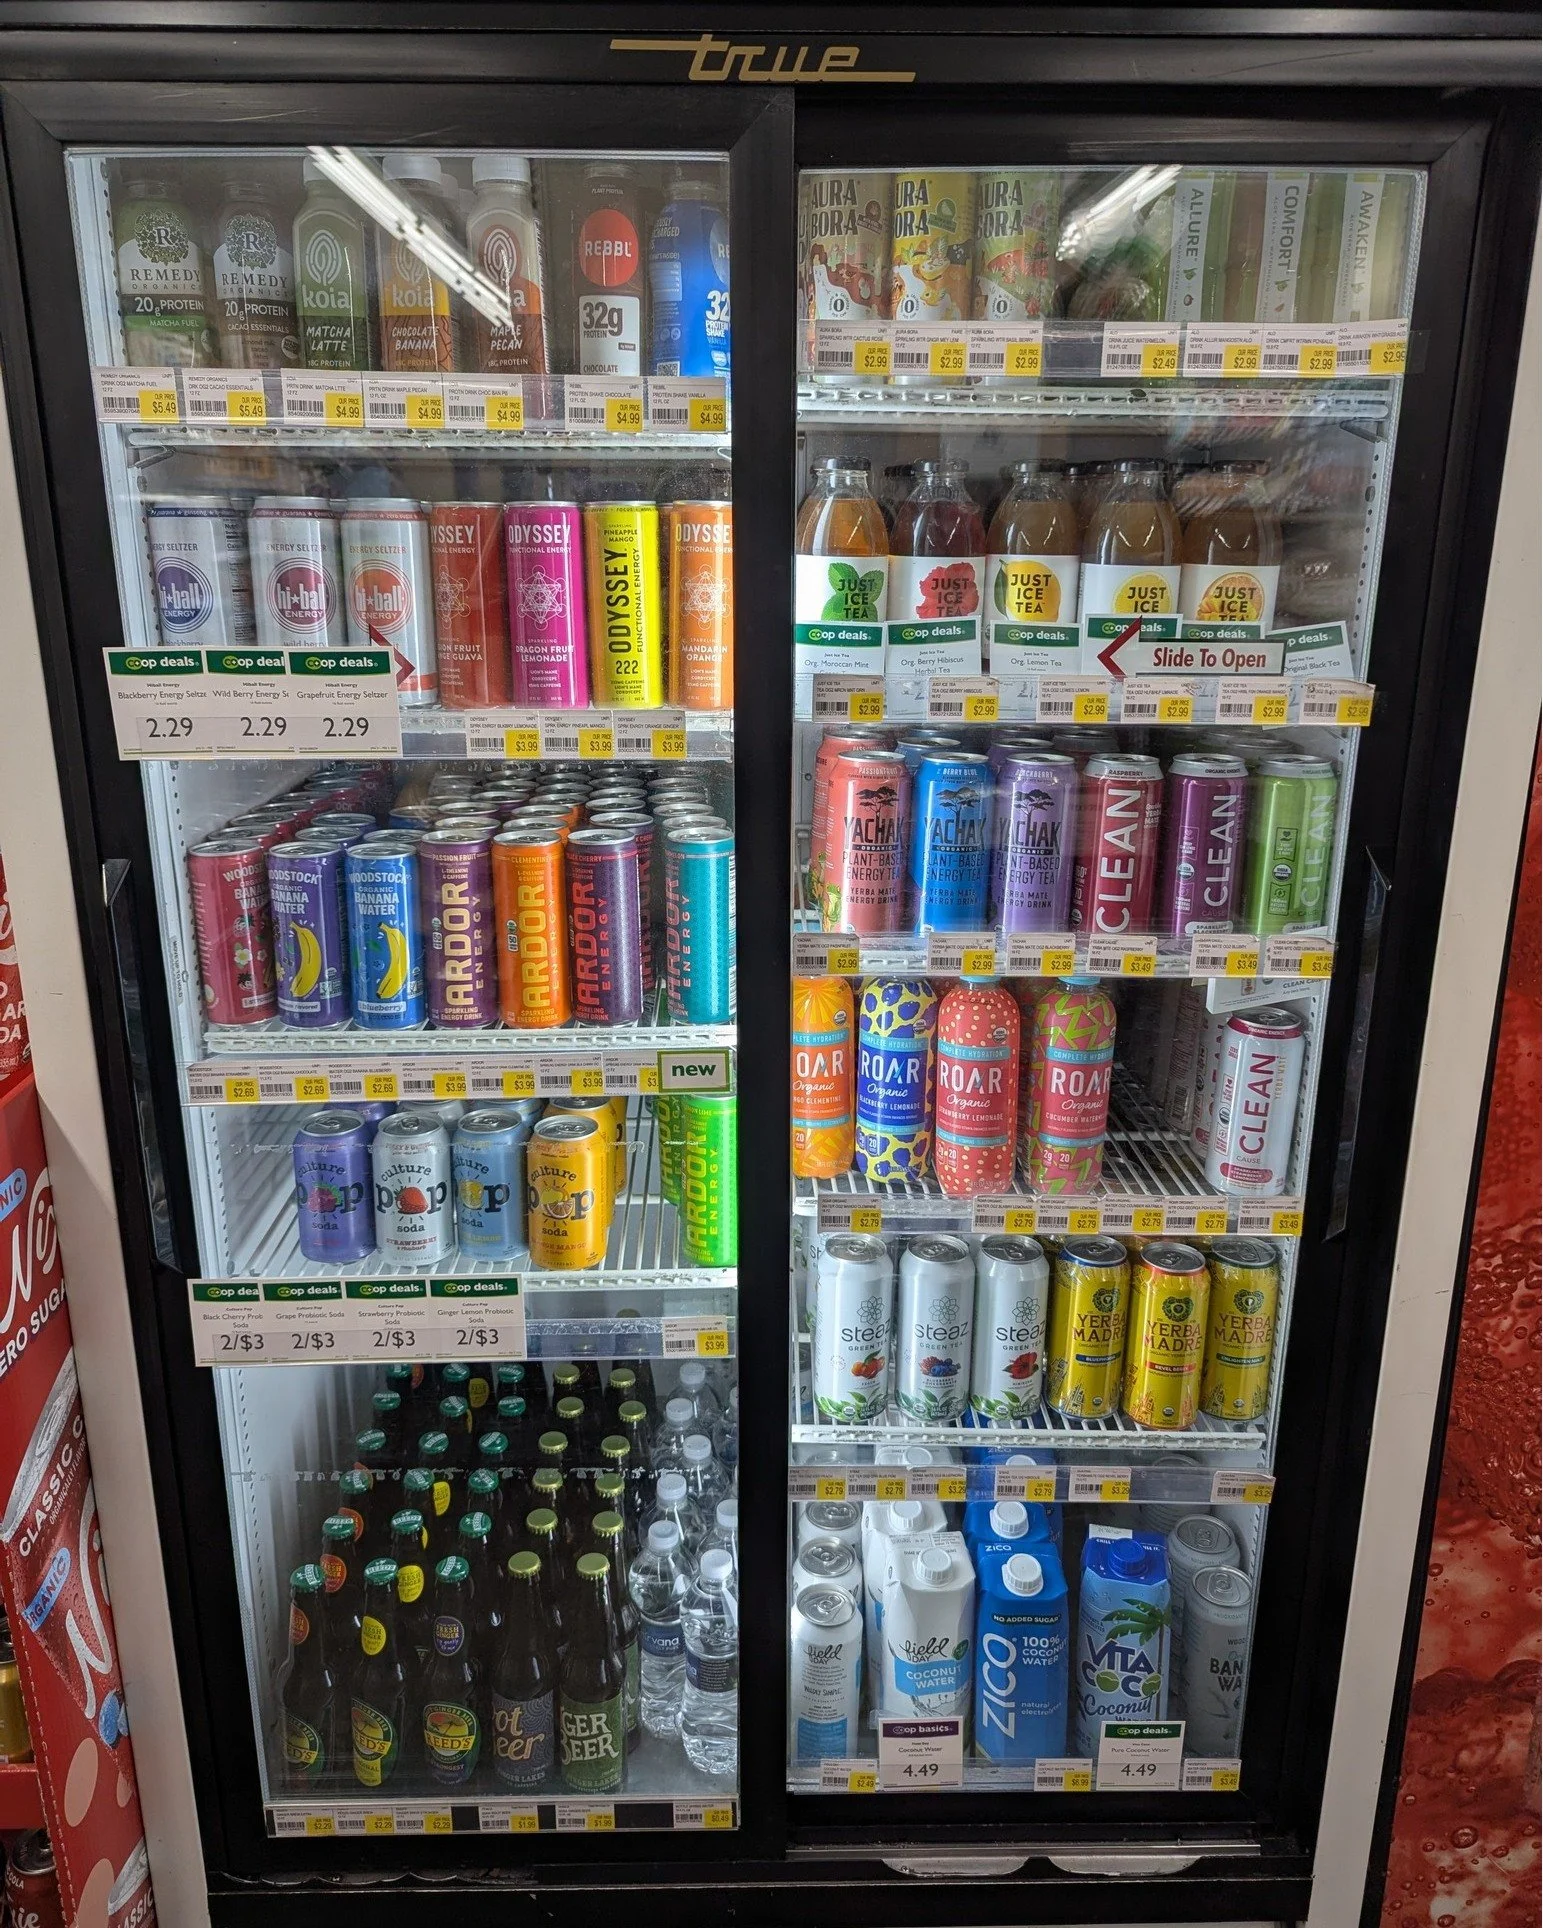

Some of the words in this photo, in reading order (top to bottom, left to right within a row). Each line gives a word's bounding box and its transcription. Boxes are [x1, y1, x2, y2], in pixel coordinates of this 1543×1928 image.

[611, 34, 915, 81] true
[811, 179, 858, 209] AURA
[811, 209, 860, 239] BORA
[1184, 187, 1205, 257] ALLURE
[1281, 185, 1300, 271] COMFORT
[1352, 189, 1375, 272] AWAKEN
[585, 240, 632, 258] REBBL
[130, 268, 201, 281] REMEDY
[221, 273, 288, 288] REMEDY
[302, 285, 351, 309] koia
[392, 286, 435, 308] koia
[161, 300, 204, 311] PROTEIN
[244, 303, 289, 317] PROTEIN
[150, 319, 180, 328] MATCHA
[182, 319, 199, 327] FUEL
[582, 302, 624, 337] 32g
[228, 323, 249, 331] CACAO
[249, 323, 289, 333] ESSENTIALS
[306, 325, 352, 338] MATCHA
[391, 326, 440, 338] CHOCOLATE
[490, 325, 521, 337] MAPLE
[583, 330, 608, 339] PROTEIN
[311, 339, 347, 352] LATTE
[394, 339, 437, 351] BANANA
[490, 339, 523, 351] PECAN
[583, 364, 619, 374] CHOCOLATE
[865, 355, 888, 369] $2.99
[1152, 357, 1176, 371] $2.49
[1309, 357, 1333, 371] $2.99
[152, 402, 177, 415] $5.49
[239, 404, 264, 418] $5.49
[336, 406, 360, 419] $4.99
[700, 412, 724, 425] $4.99
[431, 524, 475, 544] YSSEY
[508, 523, 571, 545] ODYSSEY
[675, 524, 733, 543] ODYSSE
[167, 542, 198, 552] SELTZER
[265, 543, 296, 552] ENERGY
[837, 578, 875, 592] JUST
[930, 577, 970, 591] JUST
[1010, 574, 1052, 587] JUST
[844, 593, 869, 606] ICE
[937, 592, 964, 605] ICE
[1016, 587, 1044, 601] ICE
[1127, 586, 1167, 600] JUST
[603, 547, 631, 654] ODYSSEY
[1133, 601, 1160, 614] ICE
[163, 609, 196, 618] ENERGY
[285, 610, 326, 620] ENERGY
[843, 607, 869, 620] TEA
[1015, 602, 1043, 615] TEA
[633, 584, 644, 653] FUNCTIONAL
[515, 645, 549, 654] DRAGON
[160, 656, 194, 668] deals
[337, 655, 375, 667] deals
[452, 653, 483, 662] GUAVA
[521, 654, 568, 662] LEMONADE
[804, 658, 819, 669] Org.
[820, 659, 853, 668] Moroccan
[854, 660, 869, 668] Mint
[900, 658, 916, 668] Org.
[917, 657, 936, 667] Berry
[936, 656, 964, 665] Hibiscus
[1153, 647, 1194, 668] Slide
[1199, 648, 1217, 667] To
[1222, 648, 1267, 672] Open
[615, 660, 639, 675] 222
[118, 691, 158, 700] Blackberry
[159, 691, 185, 700] Energy
[212, 690, 231, 698] Wild
[232, 690, 255, 701] Berry
[256, 690, 279, 701] Energy
[296, 690, 332, 700] Grapefruit
[333, 691, 363, 701] Energy
[363, 690, 388, 699] Seltzer
[858, 705, 880, 716] $2.99
[1083, 704, 1105, 716] $2.99
[146, 717, 194, 738] 2.29
[240, 716, 288, 737] 2.29
[322, 717, 370, 738] 2.29
[515, 741, 539, 753] $3.99
[661, 741, 685, 753] $3.99
[943, 767, 963, 776] BERRY
[963, 767, 978, 776] BLUE
[1108, 769, 1144, 778] RASPBERRY
[844, 816, 905, 846] YACHAK
[924, 816, 987, 847] YACHAK
[1203, 794, 1238, 908] CLEAN
[1300, 794, 1332, 907] CLEAN
[1095, 787, 1144, 934] CLEAN
[354, 891, 400, 905] BANANA
[358, 903, 396, 916] WATER
[441, 881, 475, 1006] ARDOR
[517, 882, 552, 1009] ARDOR
[572, 881, 600, 1007] ARDOR
[598, 898, 611, 991] ENERGY
[682, 896, 691, 988] ENERGY
[1130, 962, 1152, 973] $3.49
[671, 1061, 717, 1077] new
[796, 1049, 844, 1079] OAR
[861, 1049, 920, 1084] ROAR
[939, 1059, 1003, 1094] ROAR
[1050, 1065, 1112, 1097] ROAR
[514, 1079, 535, 1090] $3.99
[867, 1082, 909, 1098] Organic
[889, 1099, 921, 1110] LEMONADE
[946, 1093, 991, 1109] Organic
[1238, 1052, 1280, 1155] CLEAN
[971, 1111, 1004, 1122] LEMONADE
[381, 1164, 432, 1182] culture
[530, 1162, 578, 1184] culture
[396, 1223, 426, 1234] soda
[860, 1218, 880, 1228] $2.79
[1279, 1220, 1299, 1230] $3.49
[541, 1226, 569, 1237] soda
[358, 1311, 391, 1320] Strawberry
[394, 1310, 426, 1319] Probiotic
[437, 1309, 460, 1318] Ginger
[484, 1307, 514, 1316] Probiotic
[1077, 1311, 1128, 1329] YERBA
[841, 1319, 891, 1343] steaz
[914, 1321, 970, 1341] steaz
[995, 1319, 1047, 1343] steaz
[1072, 1327, 1126, 1342] MADRE
[1147, 1319, 1201, 1338] YERBA
[221, 1333, 265, 1352] 2/$3
[456, 1328, 500, 1347] 2/$3
[1144, 1336, 1202, 1352] MADRE
[848, 1343, 876, 1352] GREEN
[875, 1339, 888, 1350] TEA
[19, 1443, 73, 1557] CLASSIC
[993, 1615, 1006, 1623] NO
[1006, 1615, 1033, 1623] ADDED
[1033, 1615, 1059, 1623] SUGAR
[1086, 1633, 1156, 1676] VITA
[906, 1663, 962, 1680] COCONUT
[914, 1676, 956, 1689] WATER
[982, 1632, 1017, 1739] ZICO
[1083, 1693, 1153, 1716] Coconut
[425, 1735, 475, 1751] REED'S
[560, 1733, 620, 1764] BEER
[903, 1763, 939, 1778] 4.49
[1120, 1762, 1157, 1778] 4.49
